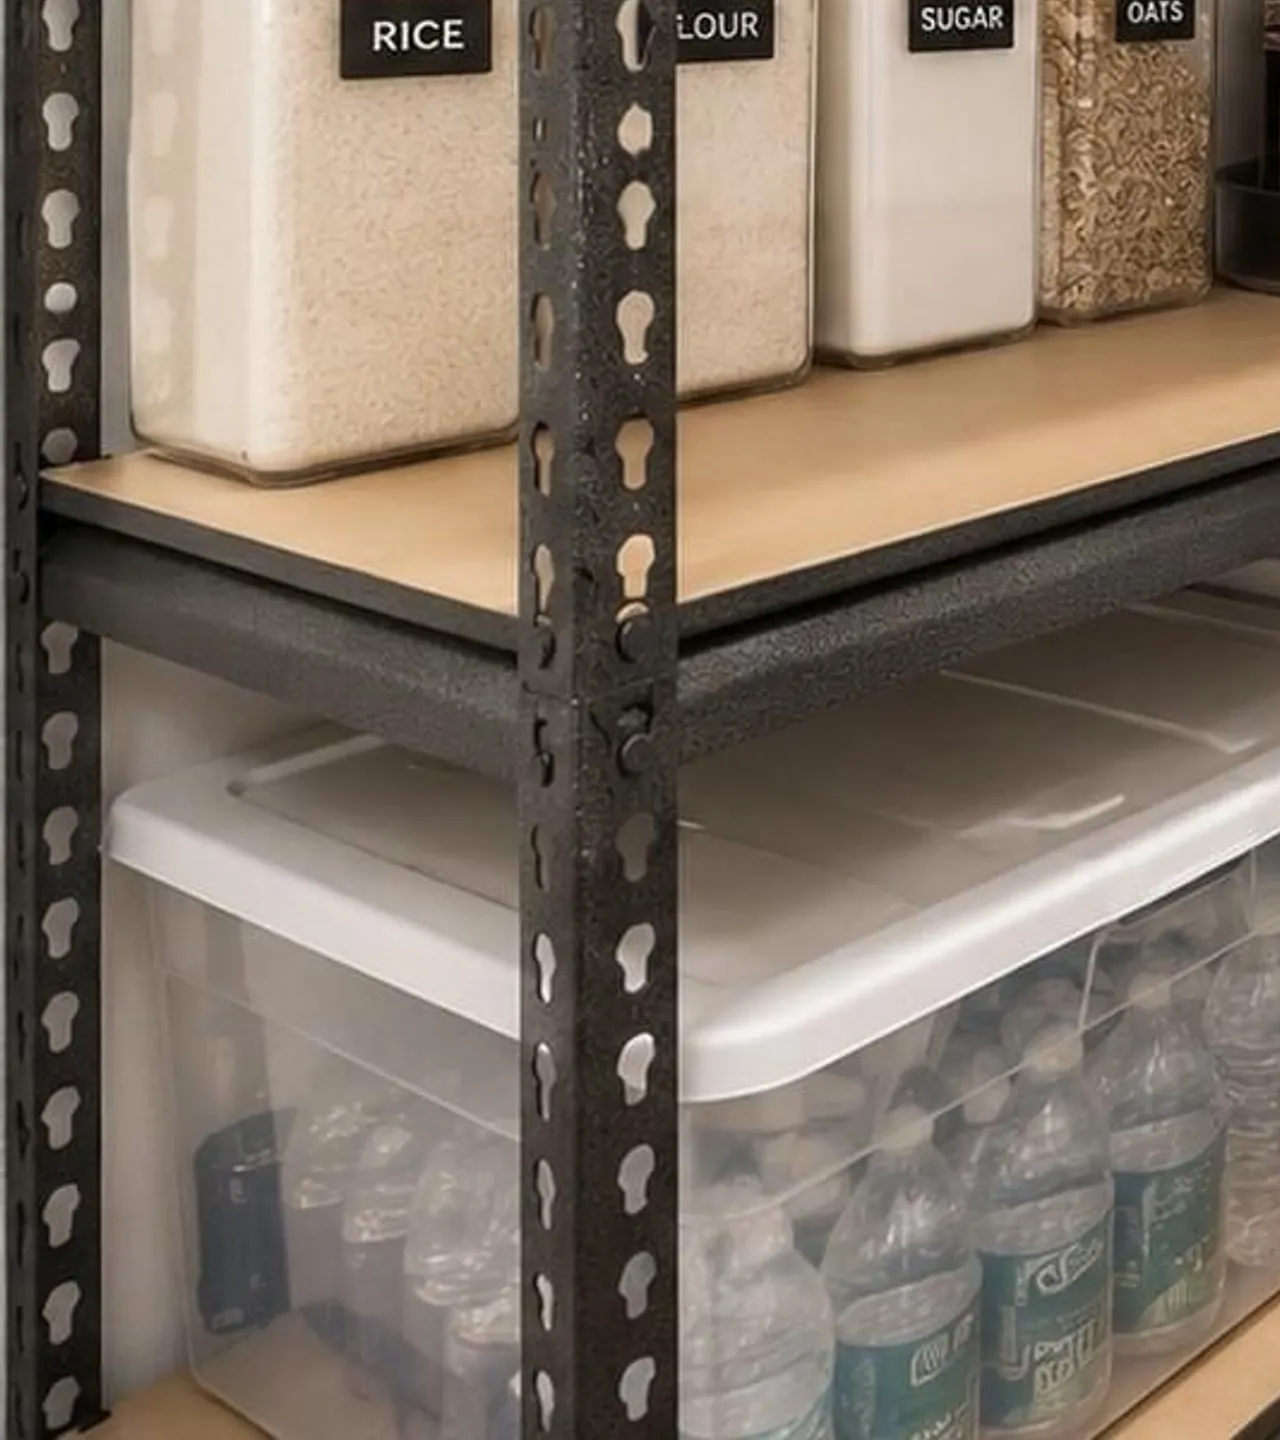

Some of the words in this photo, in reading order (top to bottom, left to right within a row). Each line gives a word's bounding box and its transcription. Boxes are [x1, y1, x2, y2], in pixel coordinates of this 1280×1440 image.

[921, 4, 1004, 31] SUGAR
[1127, 0, 1184, 23] OATS
[372, 18, 465, 51] RICE
[675, 12, 759, 40] LOUR
